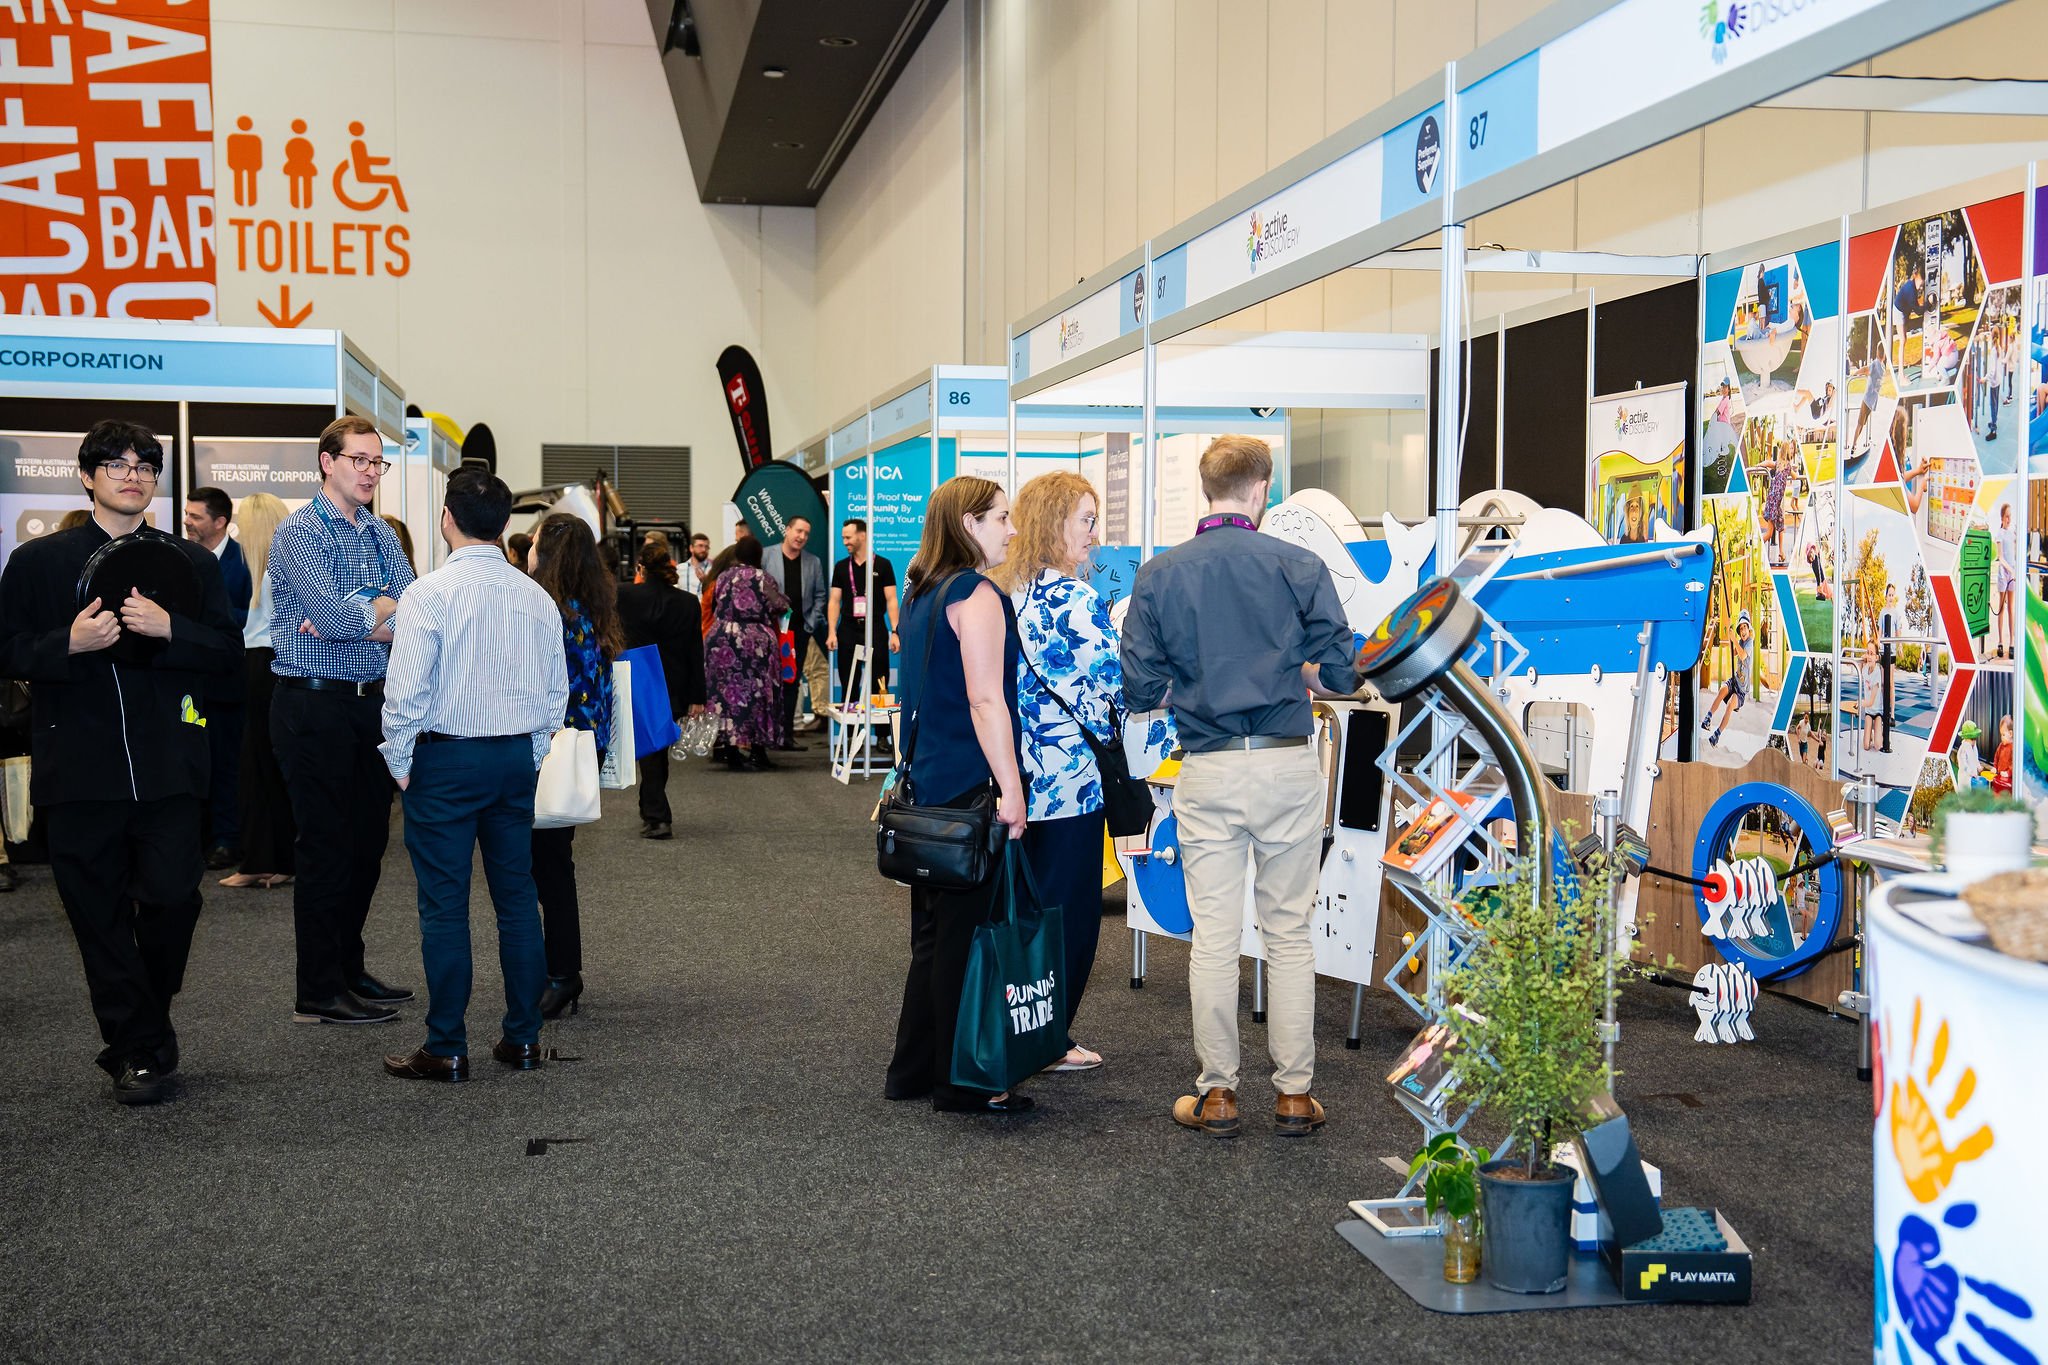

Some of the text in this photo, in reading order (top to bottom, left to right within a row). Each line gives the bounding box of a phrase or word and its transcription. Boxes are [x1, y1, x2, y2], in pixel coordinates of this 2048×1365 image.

[82, 0, 214, 190] AFE
[1469, 110, 1488, 150] 87
[99, 195, 215, 271] BAR
[1264, 211, 1288, 241] active
[229, 218, 411, 278] TOILETS
[1265, 225, 1300, 260] DISCOVERY
[1157, 275, 1166, 299] 87
[0, 350, 163, 370] CORPORATION
[949, 391, 971, 405] 86
[1629, 409, 1649, 424] active
[1629, 420, 1659, 435] DISCOVERY
[15, 465, 76, 478] TREASURY
[211, 470, 322, 483] TREASURY CORPORA
[845, 466, 903, 480] CIICA
[975, 469, 1018, 477] Transfo
[848, 493, 923, 502] Futu Proof Your
[747, 495, 776, 538] Connect
[758, 487, 787, 538] Wheatbe
[901, 505, 912, 513] By
[897, 516, 916, 524] Your
[1983, 545, 1989, 560] 2
[1005, 970, 1055, 1007] BUNNINS
[1010, 996, 1053, 1035] TRADE
